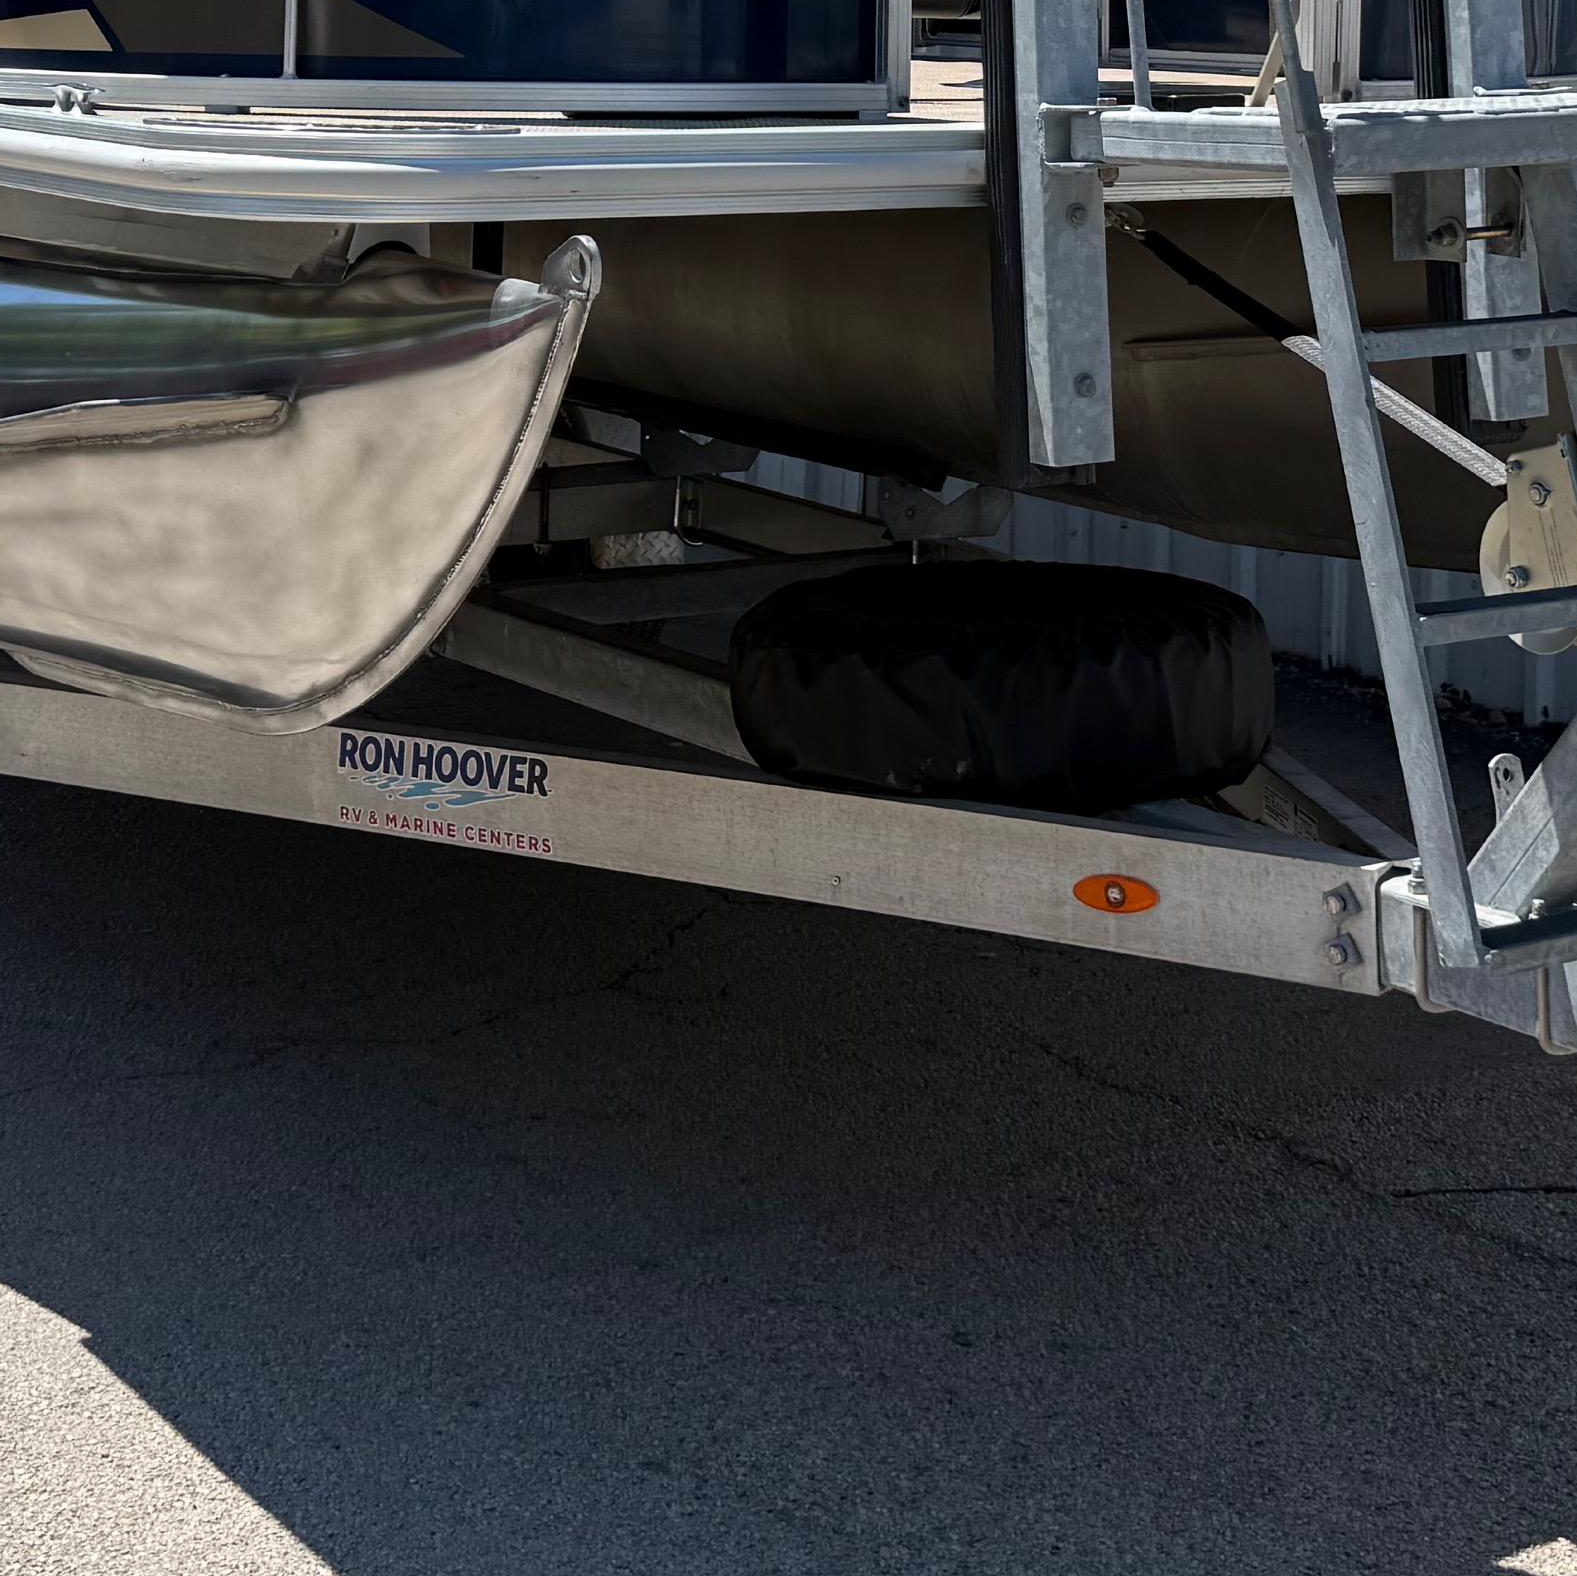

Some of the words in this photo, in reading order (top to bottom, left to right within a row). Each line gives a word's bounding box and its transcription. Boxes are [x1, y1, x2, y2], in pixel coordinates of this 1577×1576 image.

[339, 731, 406, 777] RON
[411, 743, 549, 797] HOOVER
[339, 805, 363, 823] RV
[368, 811, 379, 826] &
[385, 812, 457, 839] MARINE
[464, 826, 553, 855] CENTERS
